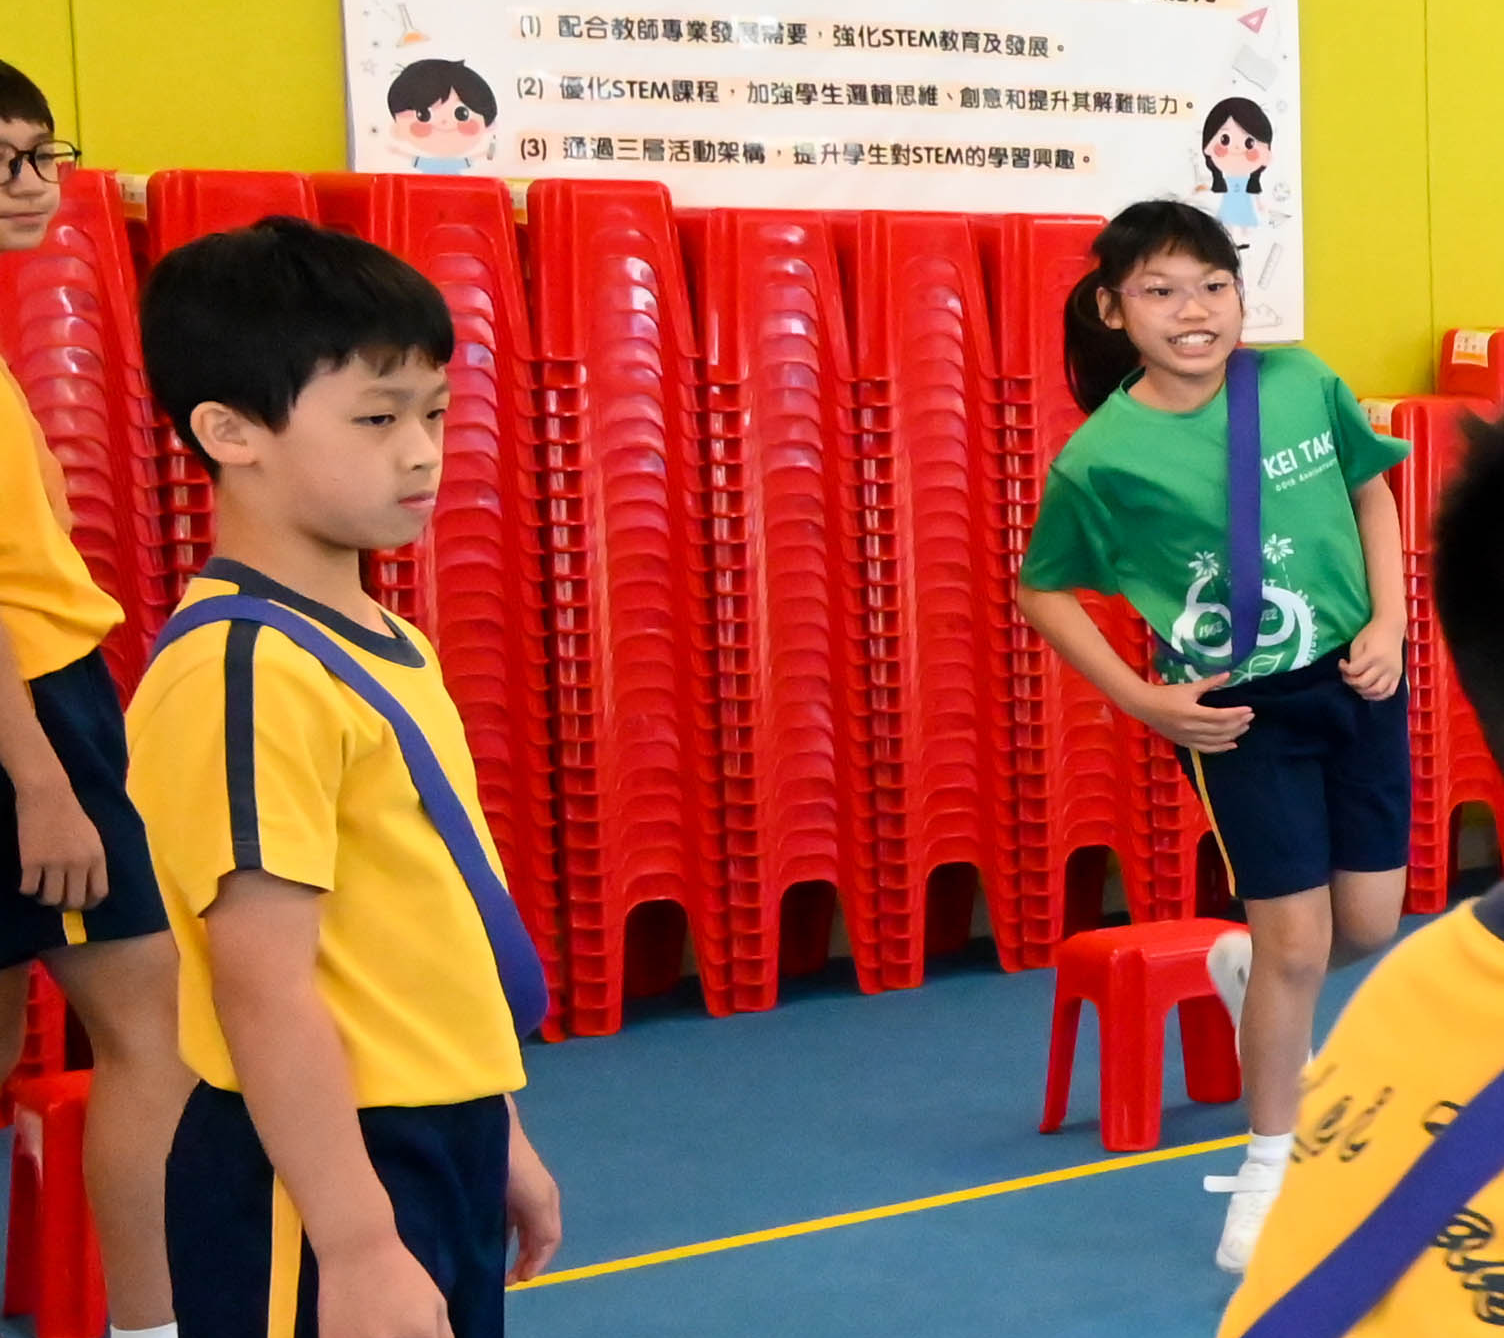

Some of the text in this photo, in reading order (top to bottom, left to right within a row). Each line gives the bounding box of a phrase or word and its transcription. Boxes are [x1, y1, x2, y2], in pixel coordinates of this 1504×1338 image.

[516, 76, 544, 100] (2)
[519, 138, 548, 162] (3)
[1262, 430, 1334, 479] KEI TAK
